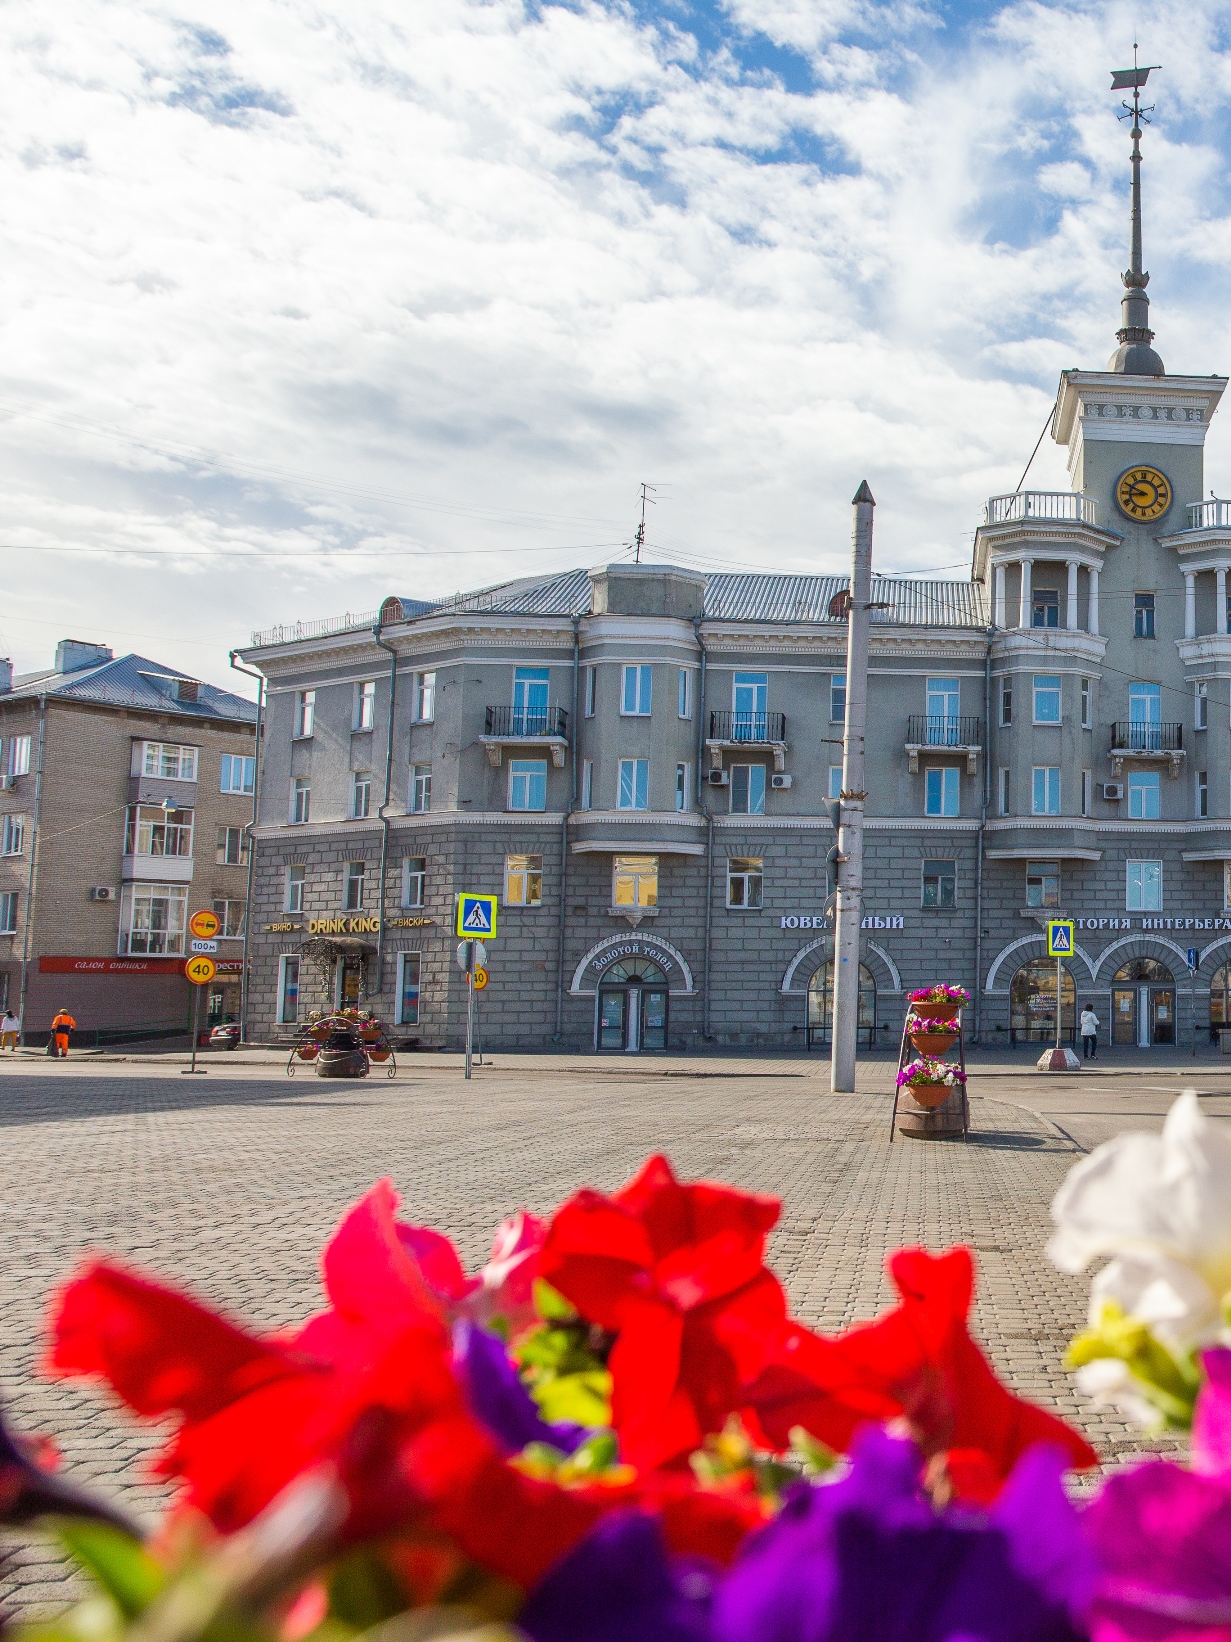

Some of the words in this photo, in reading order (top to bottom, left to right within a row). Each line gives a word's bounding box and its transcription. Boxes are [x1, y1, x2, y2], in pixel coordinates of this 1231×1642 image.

[272, 922, 292, 932] ВИНО
[309, 918, 347, 934] DRINK
[350, 917, 380, 933] KING
[398, 918, 424, 927] ВИСКИ
[780, 915, 904, 929] ЮВЕНЫЙ
[1053, 918, 1131, 930] ТОРИЯ
[592, 943, 640, 971] Золотой
[643, 946, 674, 972] телец
[75, 961, 104, 969] салон
[109, 961, 147, 970] оптики
[192, 964, 210, 976] 40
